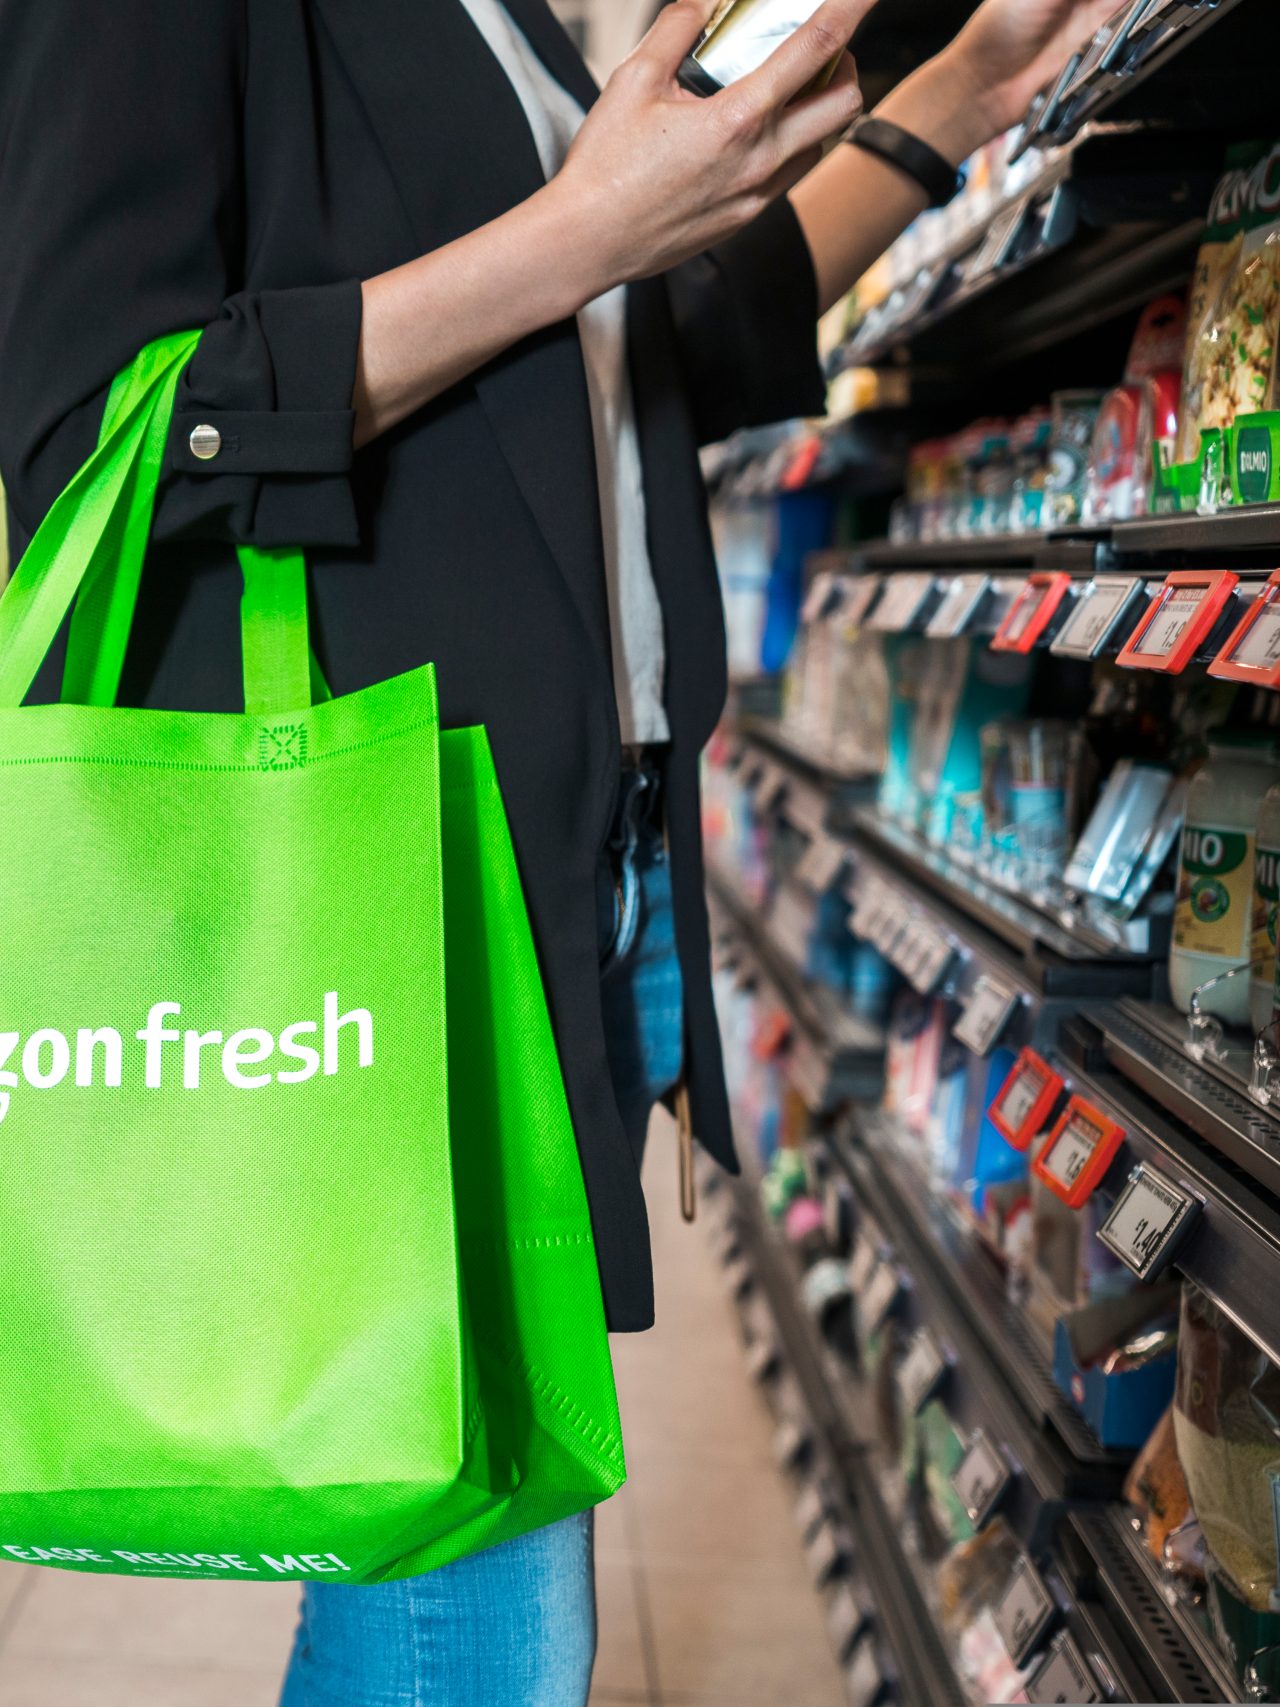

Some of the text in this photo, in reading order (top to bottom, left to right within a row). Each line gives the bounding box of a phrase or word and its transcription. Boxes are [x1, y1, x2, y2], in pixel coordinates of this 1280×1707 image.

[136, 990, 374, 1090] fresh
[111, 1550, 260, 1572] REUSE
[259, 1553, 352, 1574] ME!
